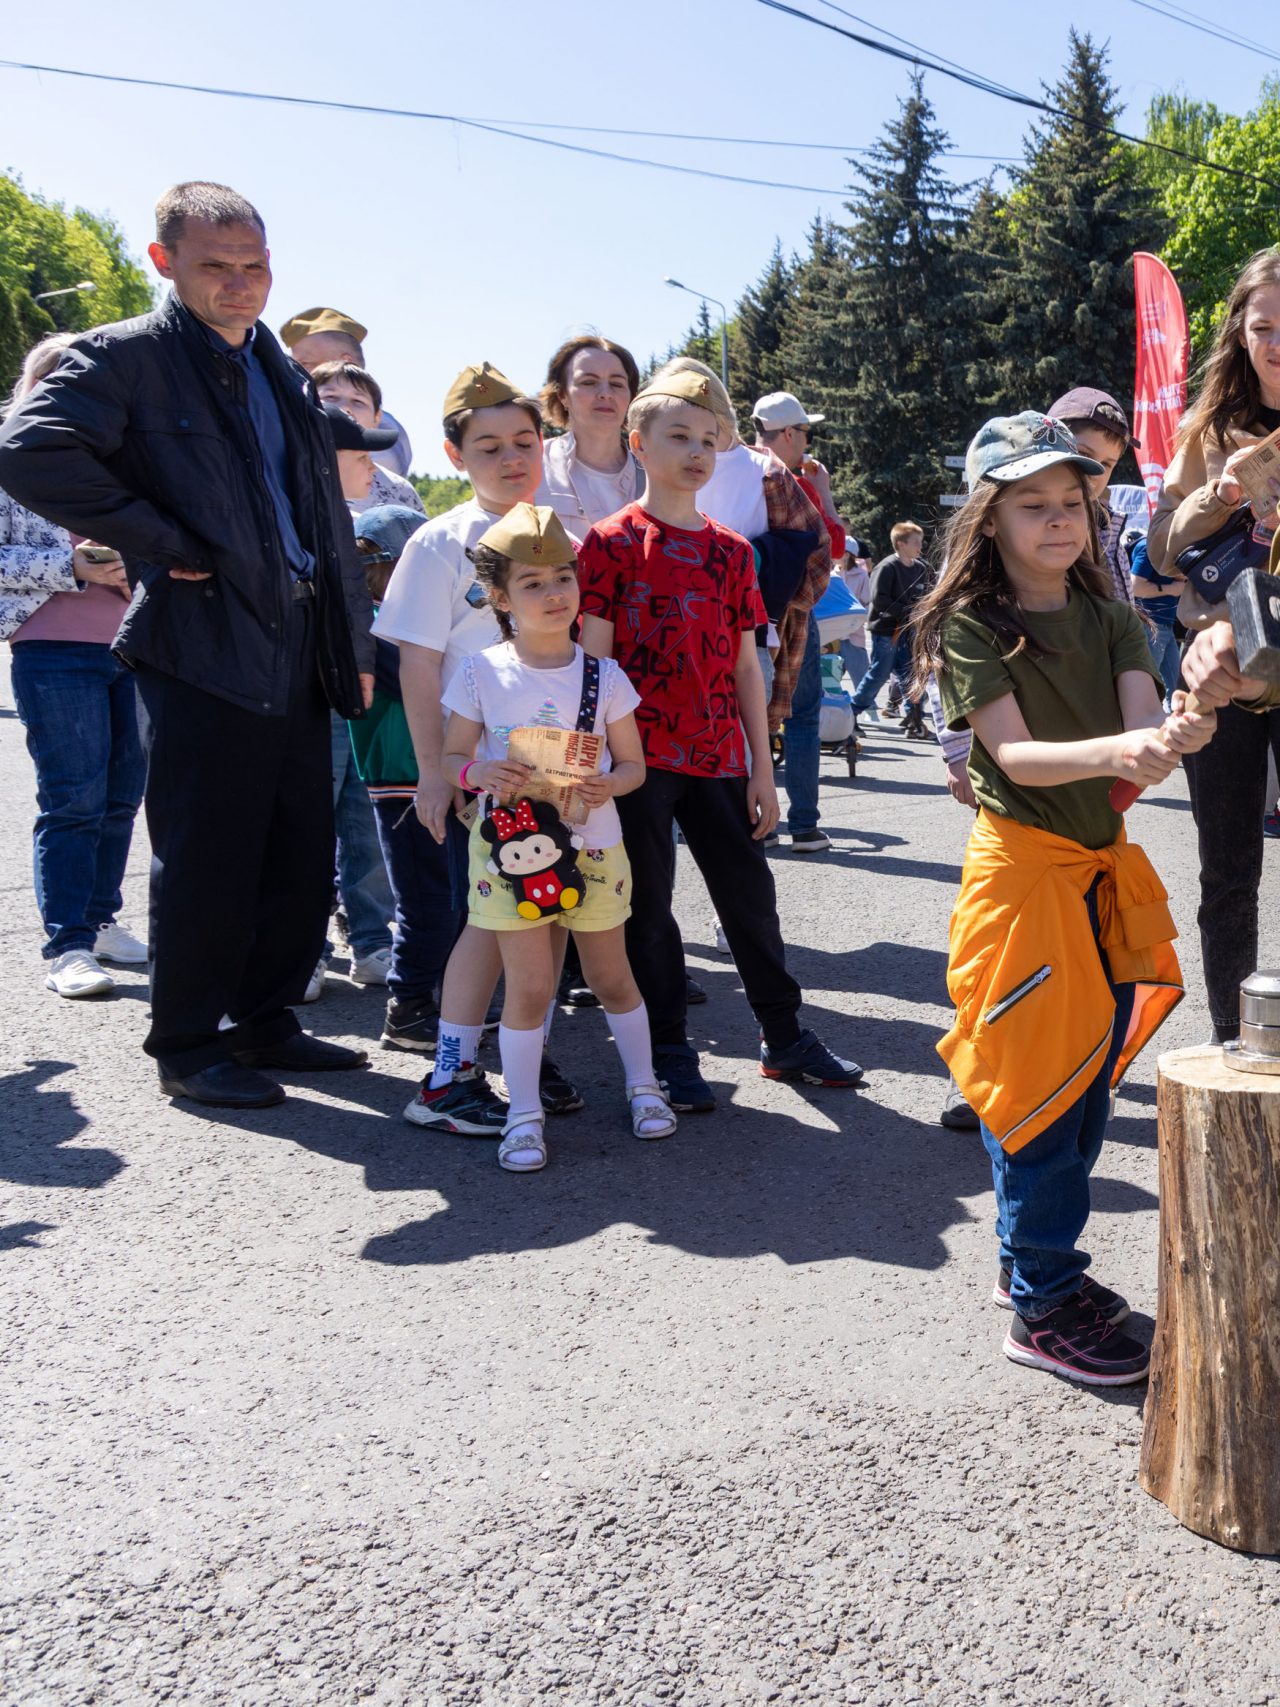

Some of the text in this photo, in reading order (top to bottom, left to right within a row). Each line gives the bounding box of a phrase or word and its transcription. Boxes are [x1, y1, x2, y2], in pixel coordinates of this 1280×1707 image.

[564, 733, 579, 766] ПОБЕДЫ
[579, 735, 599, 769] ПАРК
[545, 769, 585, 779] ПАТРИОТИЧЕС
[441, 1034, 461, 1071] SOME
